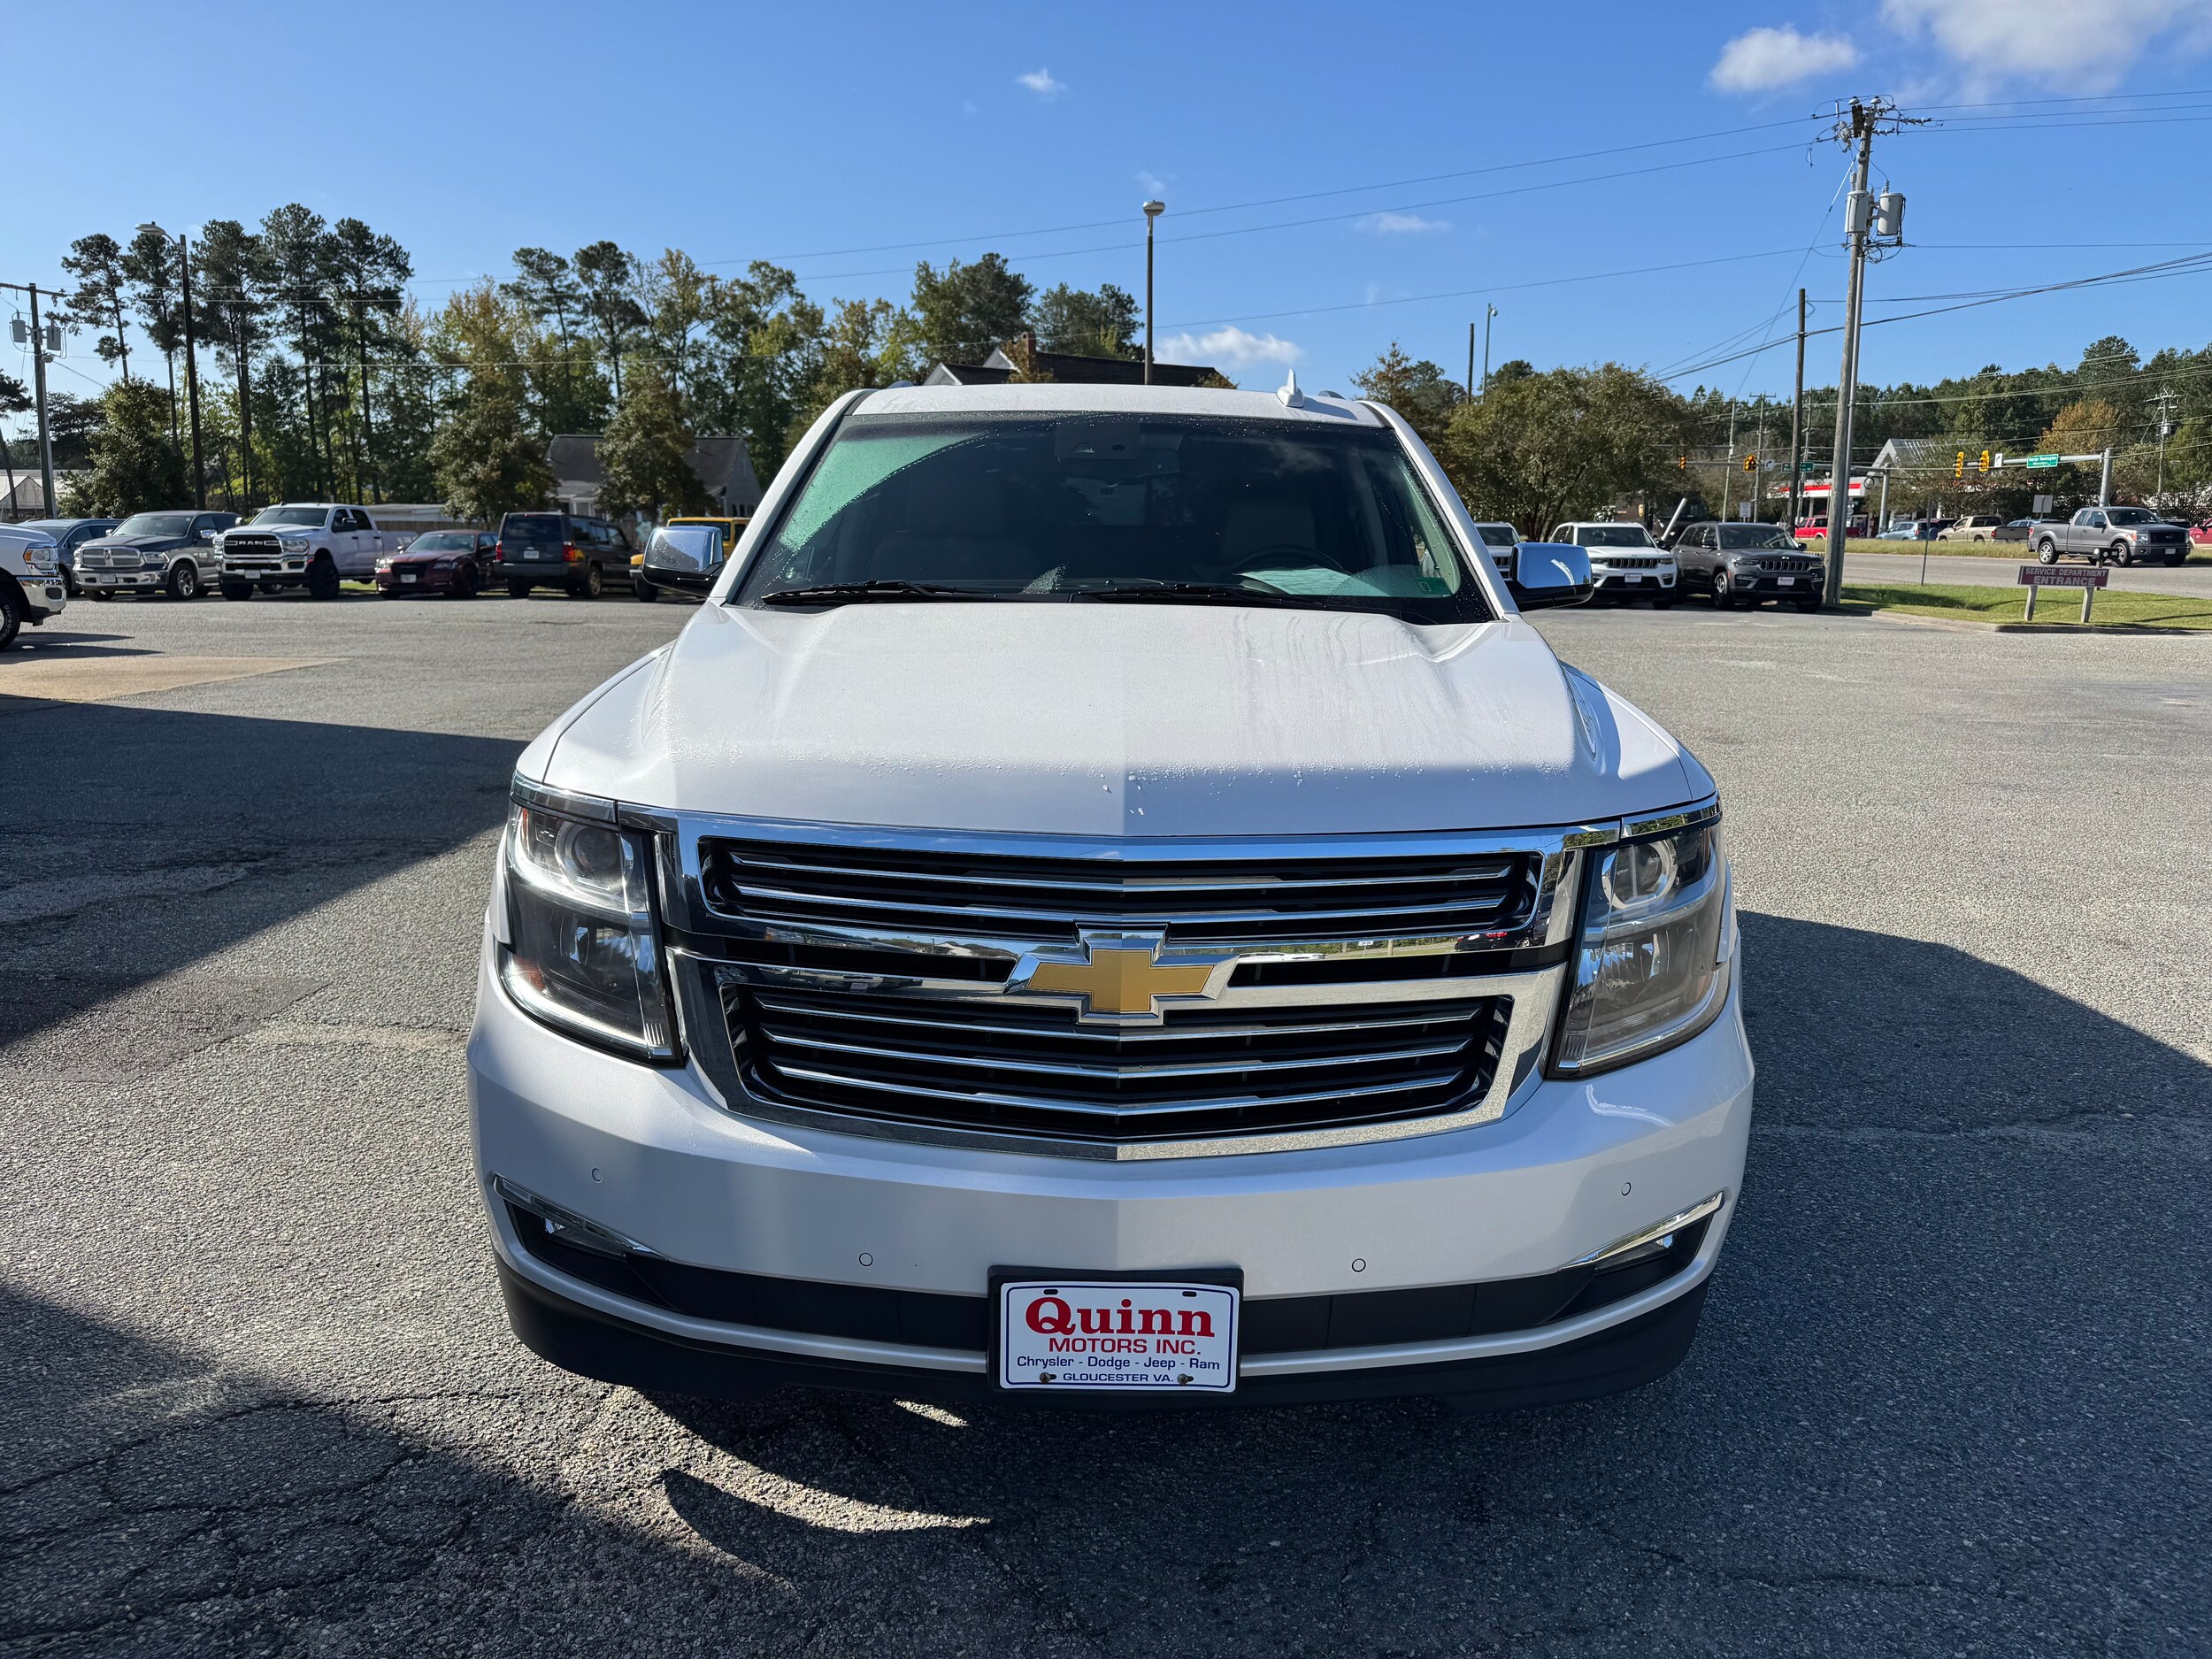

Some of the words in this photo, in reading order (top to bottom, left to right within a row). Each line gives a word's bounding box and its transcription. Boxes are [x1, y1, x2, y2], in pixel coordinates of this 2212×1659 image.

[2025, 567, 2056, 576] SERVICE
[2059, 568, 2108, 577] DEPARTMENT
[2033, 576, 2096, 586] ENTRANCE
[1422, 582, 1429, 591] 9
[1025, 1296, 1215, 1338] Quinn
[1048, 1338, 1148, 1353] MOTORS
[1156, 1339, 1202, 1356] INC.
[1017, 1356, 1074, 1370] Chrysler
[1088, 1356, 1131, 1370] Dodge
[1144, 1356, 1176, 1371] Jeep
[1190, 1357, 1220, 1370] Ram
[1063, 1373, 1148, 1382] GLOUCESTER
[1153, 1373, 1174, 1383] VA.
